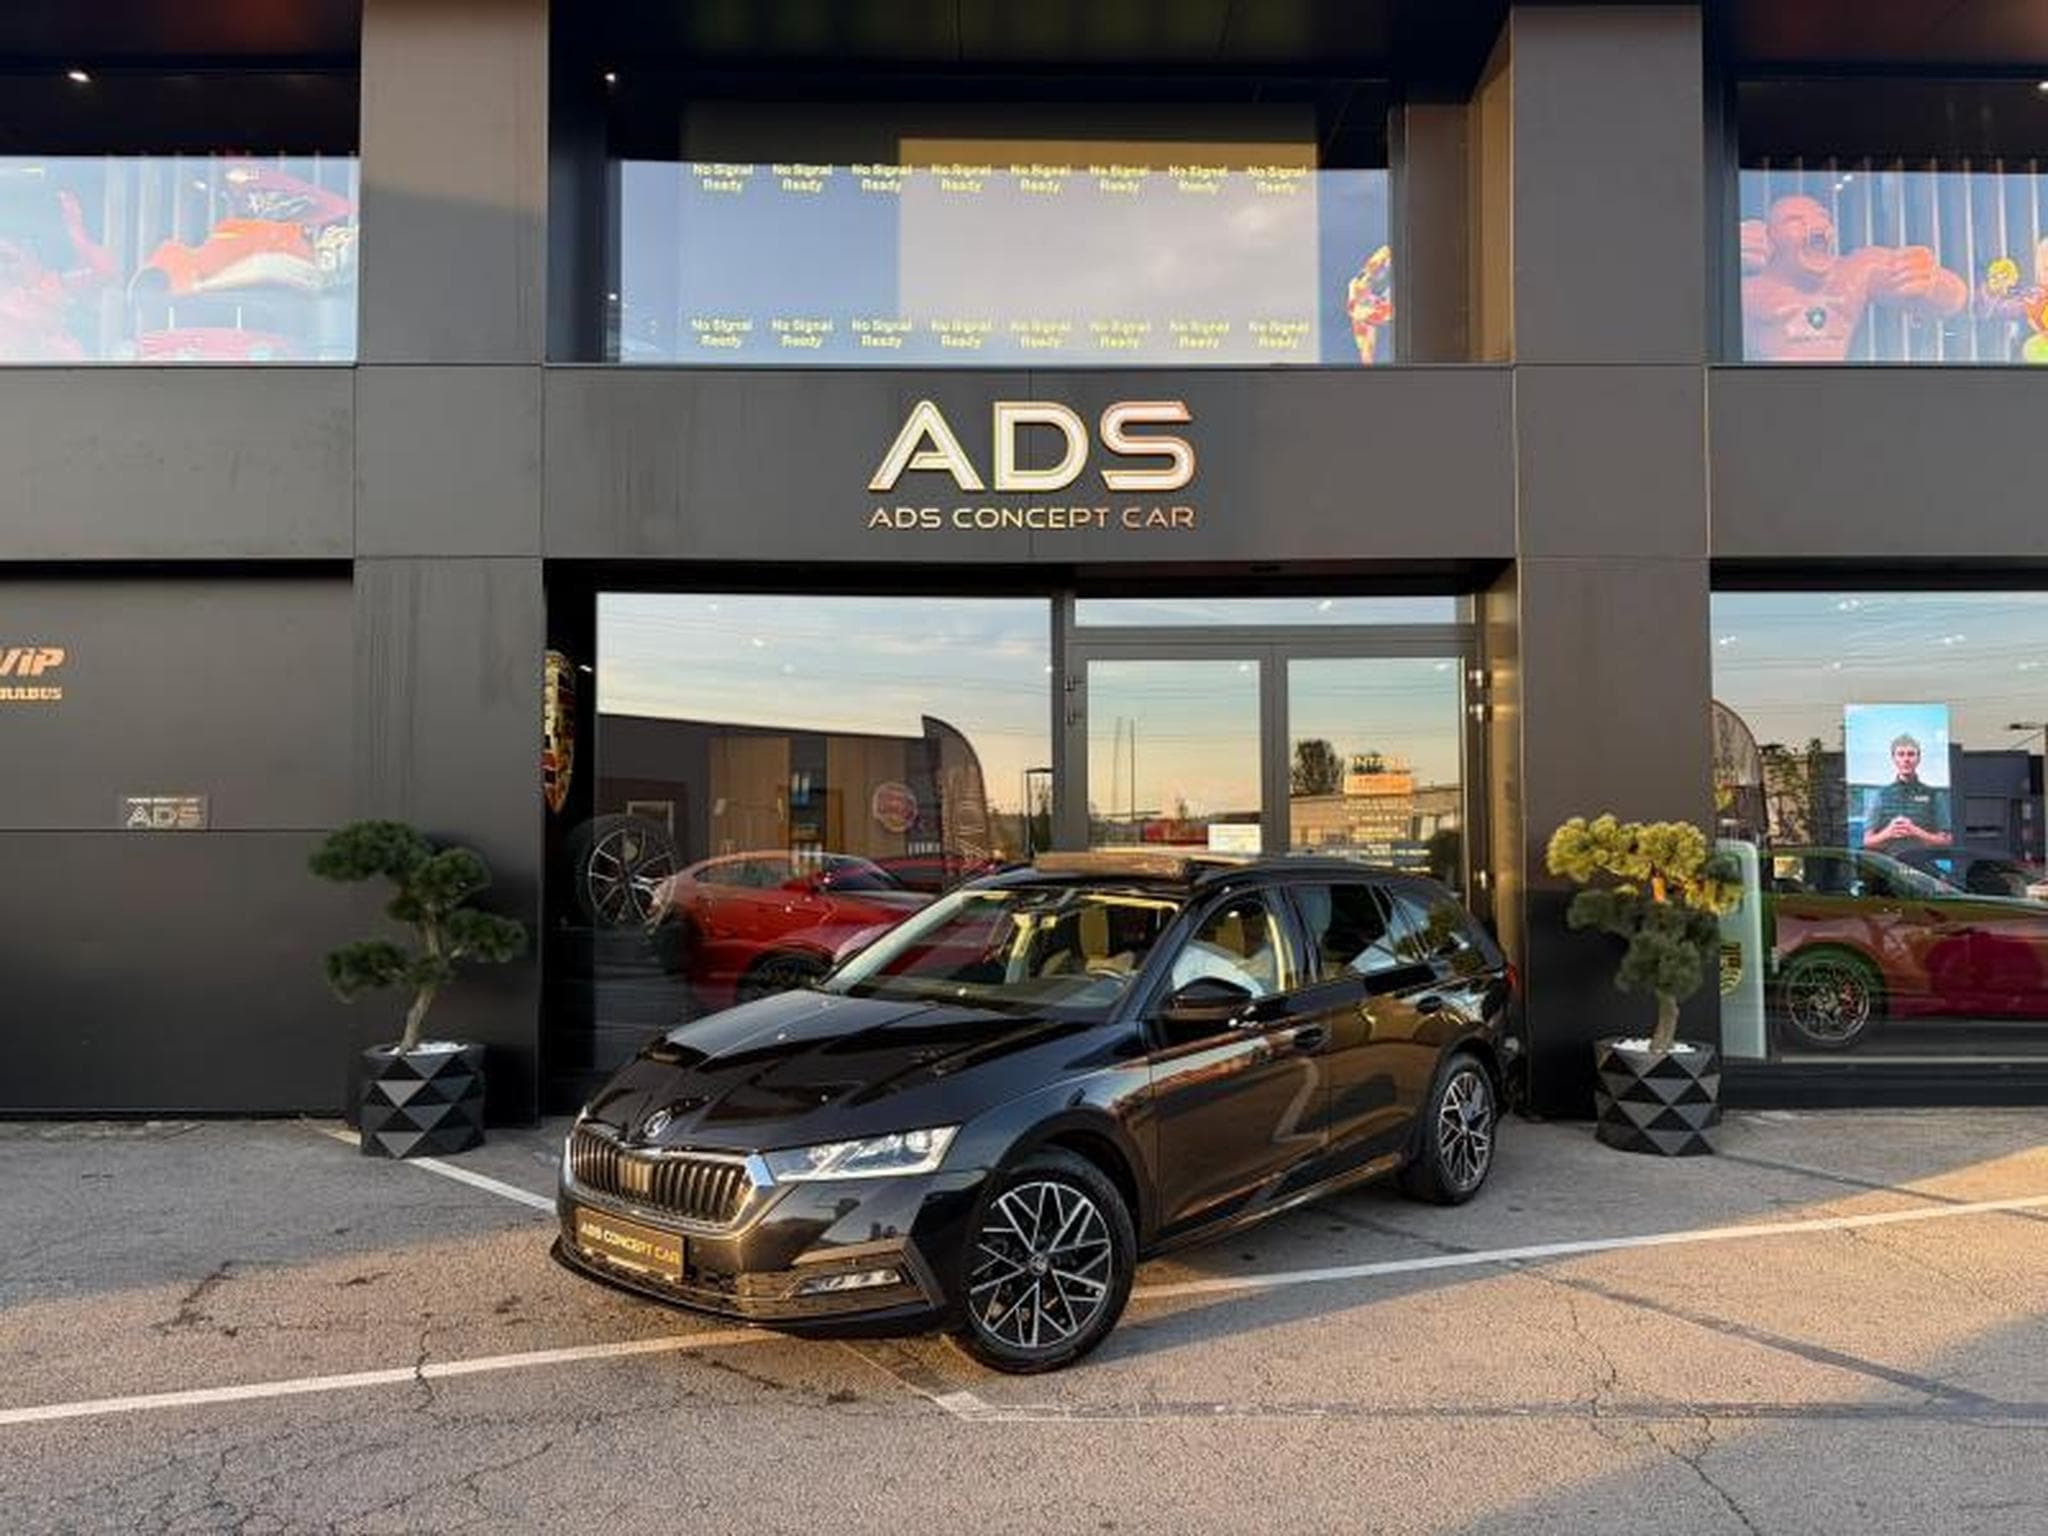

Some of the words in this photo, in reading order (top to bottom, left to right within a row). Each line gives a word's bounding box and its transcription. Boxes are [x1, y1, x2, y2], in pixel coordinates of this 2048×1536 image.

[868, 400, 1196, 491] ADS
[868, 508, 942, 529] ADS
[952, 507, 1110, 529] CONCEPT
[1121, 507, 1195, 529] CAR
[127, 806, 201, 829] ADS
